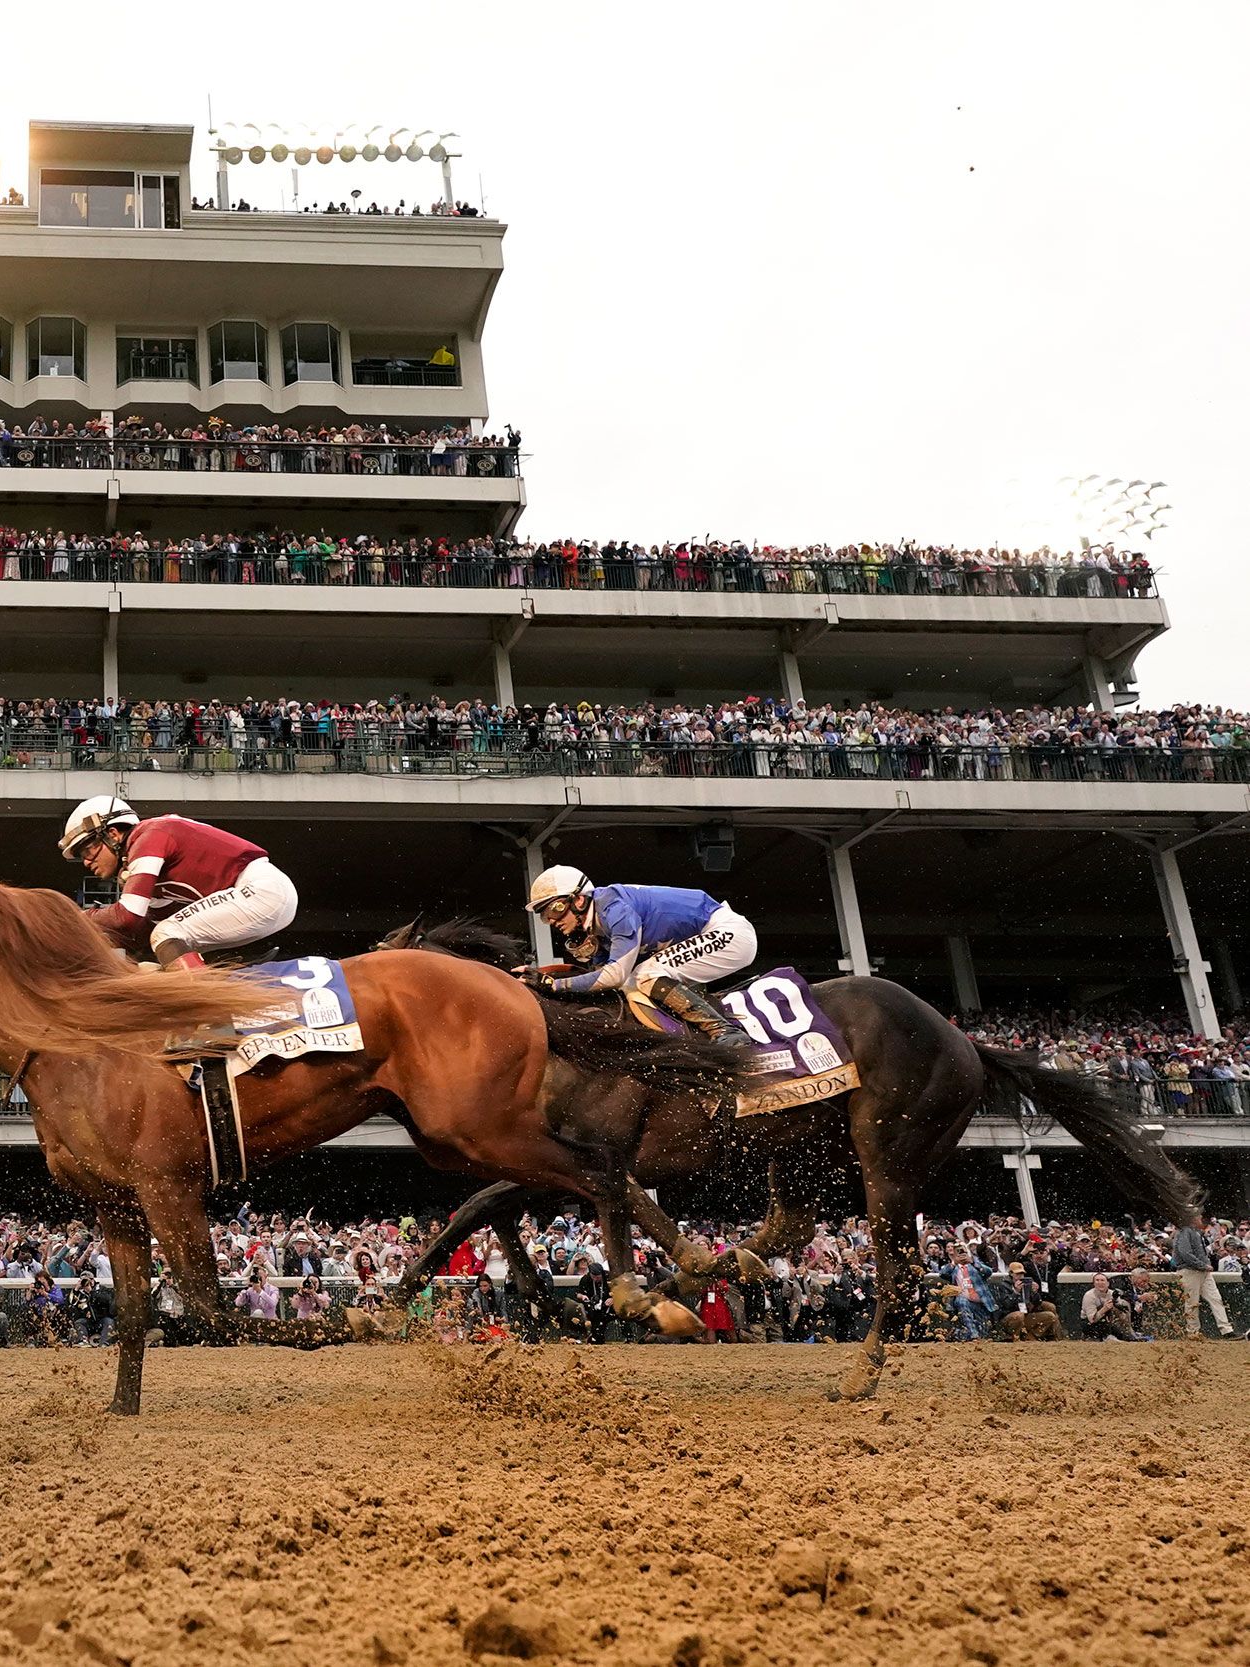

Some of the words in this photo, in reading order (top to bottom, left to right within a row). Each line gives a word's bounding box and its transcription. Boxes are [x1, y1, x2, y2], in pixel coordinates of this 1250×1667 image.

[174, 890, 236, 922] SENTIENT
[280, 956, 333, 990] 3
[307, 1007, 339, 1026] DERBY
[721, 976, 814, 1044] 10
[241, 1030, 350, 1061] EPICENTER
[807, 1052, 837, 1071] DERBY
[756, 1073, 847, 1109] ZANDON
